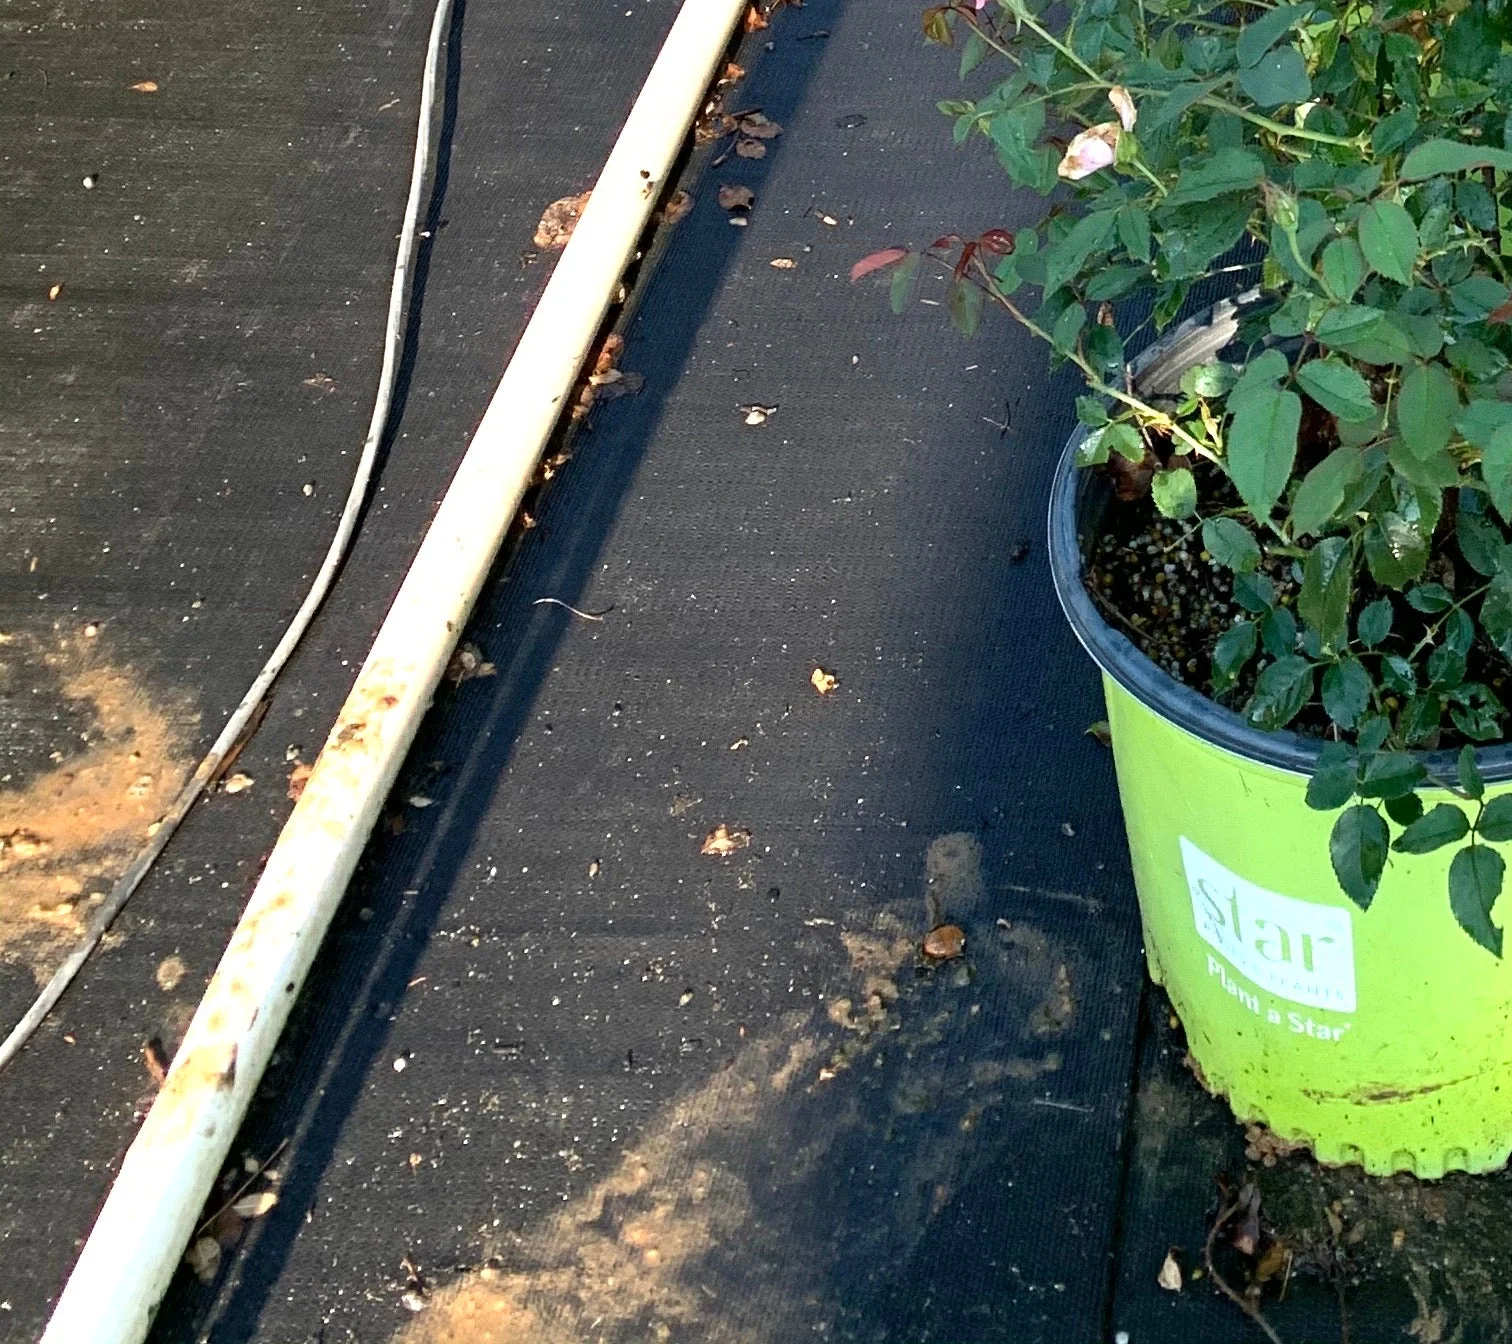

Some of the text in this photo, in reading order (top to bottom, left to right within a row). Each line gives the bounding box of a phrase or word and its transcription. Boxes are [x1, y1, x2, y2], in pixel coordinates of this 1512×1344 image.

[1206, 952, 1346, 1042] Plant a Star
